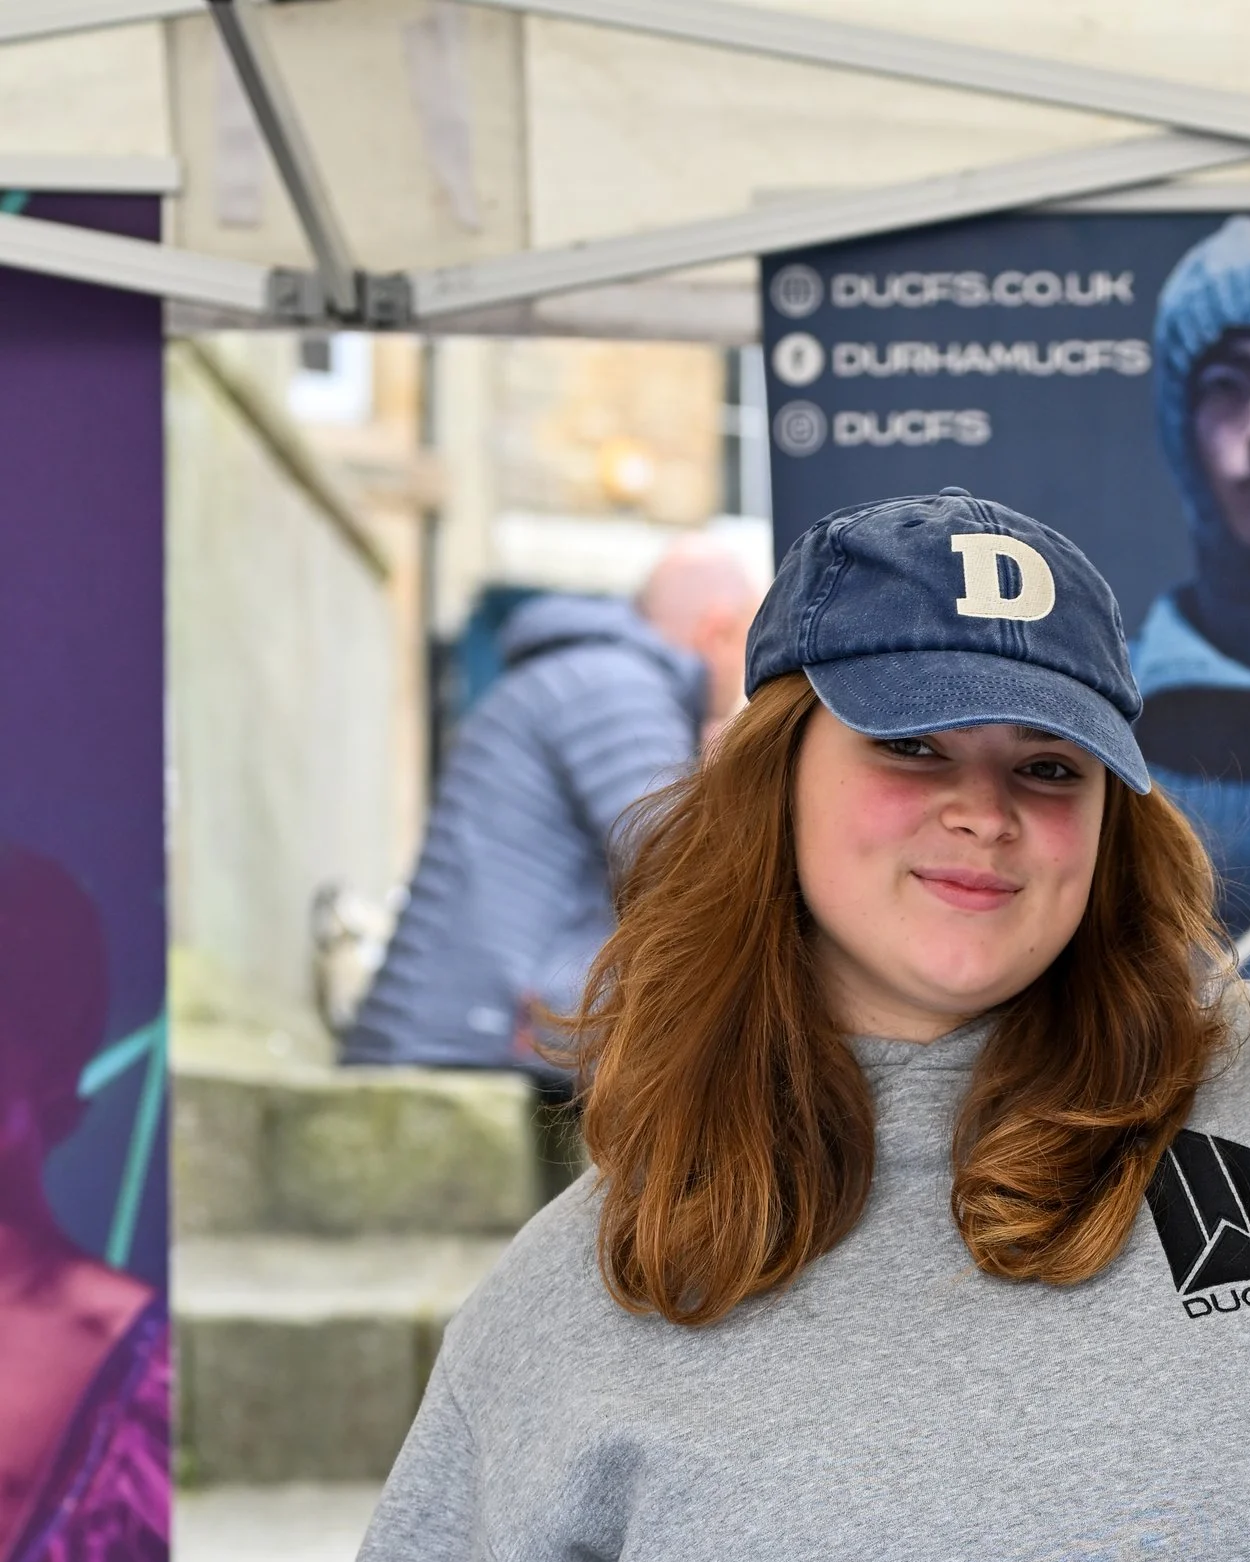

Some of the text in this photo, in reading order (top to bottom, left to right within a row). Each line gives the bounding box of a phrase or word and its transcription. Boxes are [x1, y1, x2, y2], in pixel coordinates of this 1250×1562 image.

[831, 271, 1134, 307] DUCFS.CO.UK
[832, 339, 1151, 377] DURHAMUCFS
[833, 409, 991, 446] DUCFS
[951, 533, 1055, 621] D
